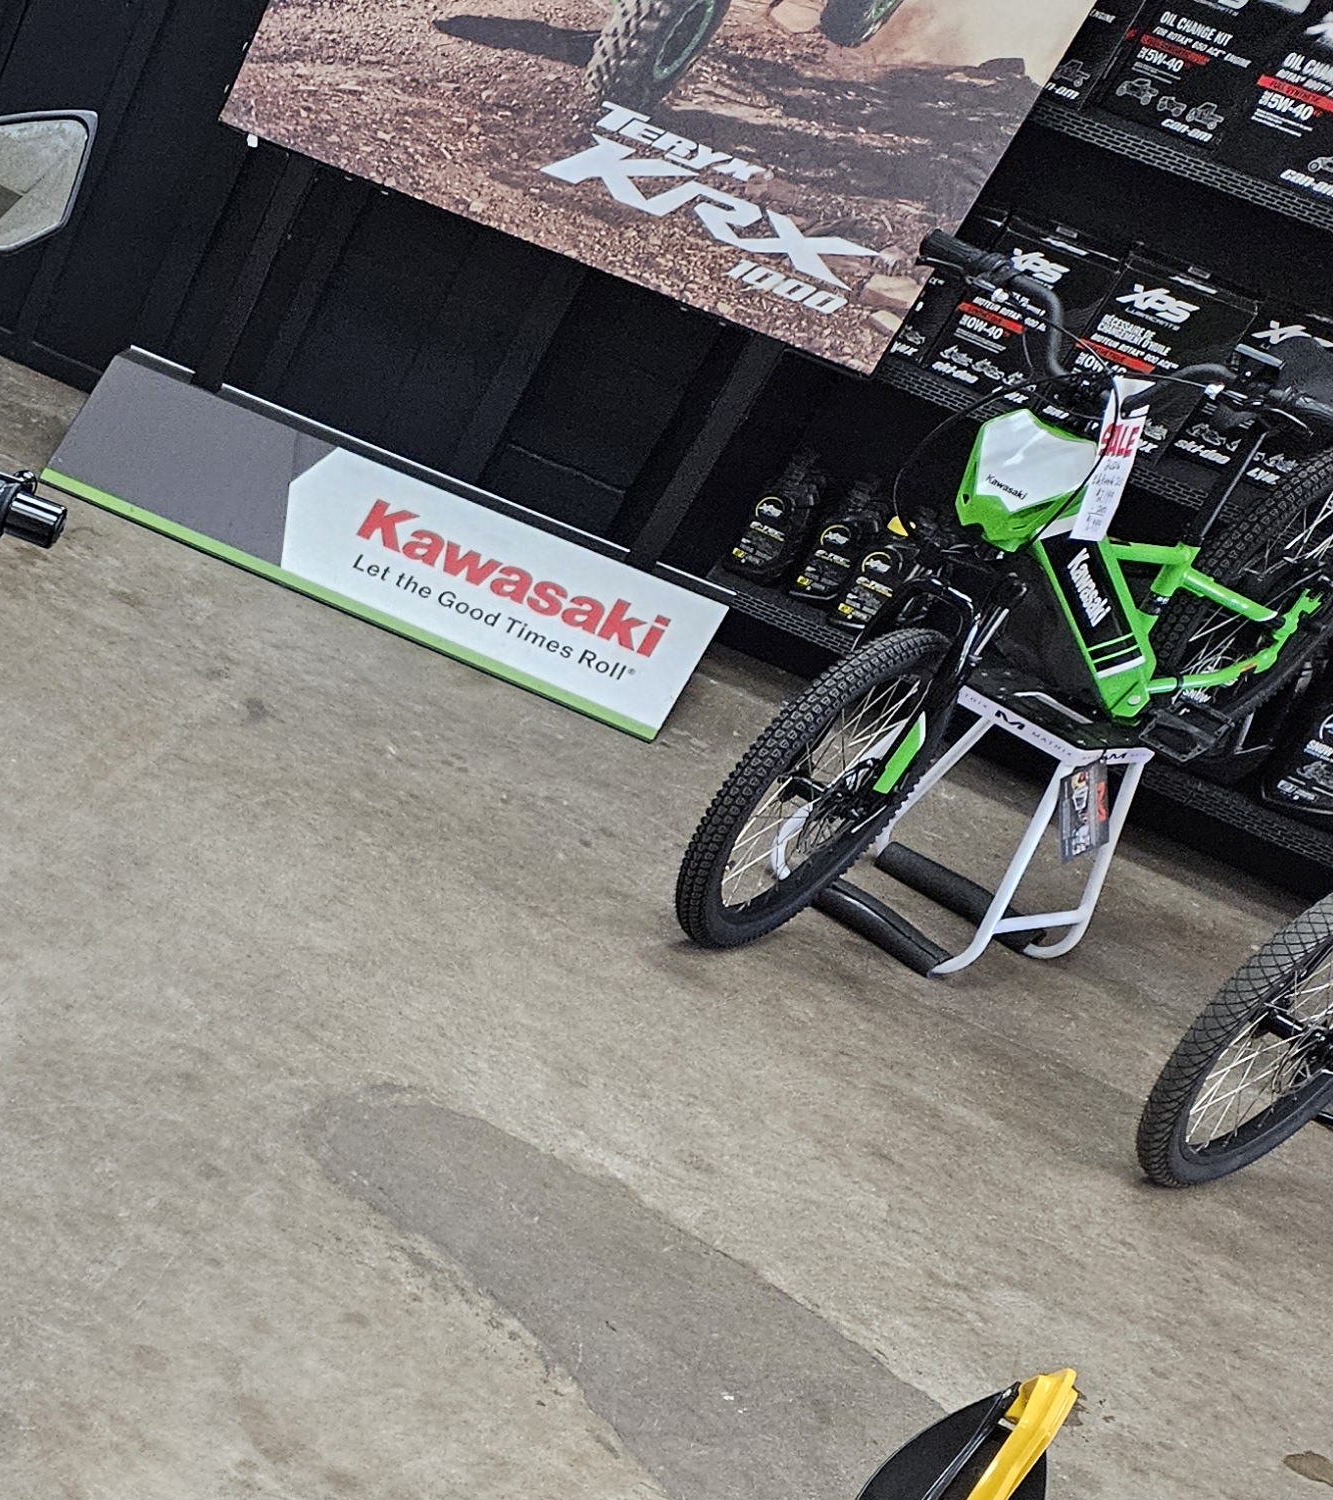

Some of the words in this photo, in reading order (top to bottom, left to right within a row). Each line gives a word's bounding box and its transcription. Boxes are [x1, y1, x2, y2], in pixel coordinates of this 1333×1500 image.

[1160, 11, 1178, 27] OIL
[1176, 17, 1217, 41] CHANGE
[1214, 31, 1233, 46] KIT
[1145, 48, 1184, 72] 5W-40
[1283, 52, 1303, 71] OIL
[1267, 95, 1315, 121] 5W-40
[540, 133, 881, 291] KRX
[726, 259, 849, 314] 1000
[973, 297, 1001, 312] MOTEUR
[1116, 284, 1200, 323] XPS
[967, 317, 1004, 340] 0W-40
[1100, 314, 1145, 336] NÉCESSAIRE
[1143, 330, 1156, 340] DE
[1090, 333, 1120, 348] MOTEUR
[1099, 422, 1140, 458] SALE
[985, 474, 1028, 500] Kawasaki
[356, 498, 672, 658] Kawasaki
[1067, 547, 1111, 628] Kawasaki
[352, 554, 392, 582] Let
[396, 574, 431, 599] the
[437, 590, 502, 628] Good
[506, 617, 572, 660] Times
[1306, 740, 1333, 757] SNOW
